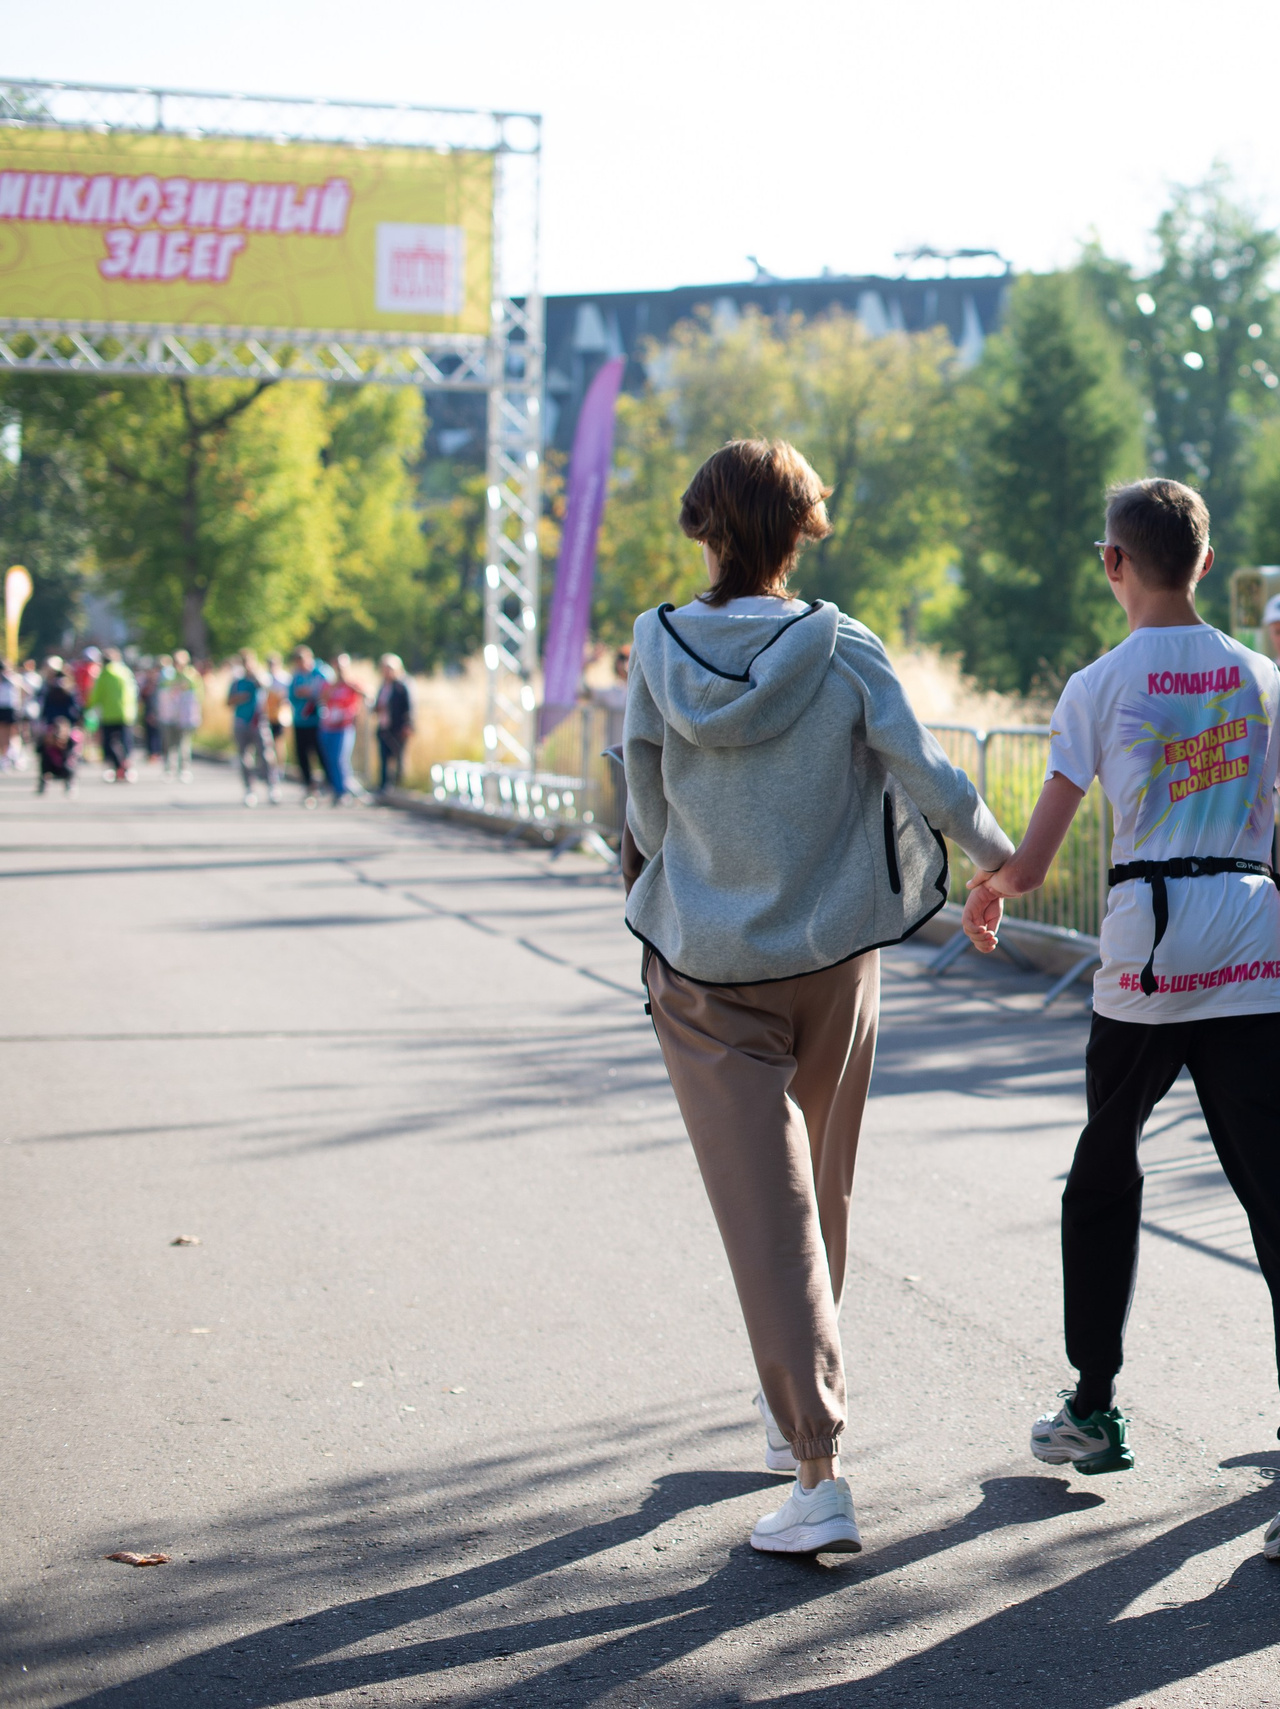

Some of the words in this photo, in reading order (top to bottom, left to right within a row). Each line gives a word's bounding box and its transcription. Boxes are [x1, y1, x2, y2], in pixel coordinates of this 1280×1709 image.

[0, 171, 350, 235] ИНКЛЮЗИВНЫЙ
[102, 230, 243, 281] ЗАБЕГ
[1148, 666, 1241, 695] КОМАНДА
[1175, 719, 1246, 761] БОЛЬШЕ
[1191, 745, 1224, 772] ЧЕМ
[1172, 759, 1249, 801] МОЖЕШЬ
